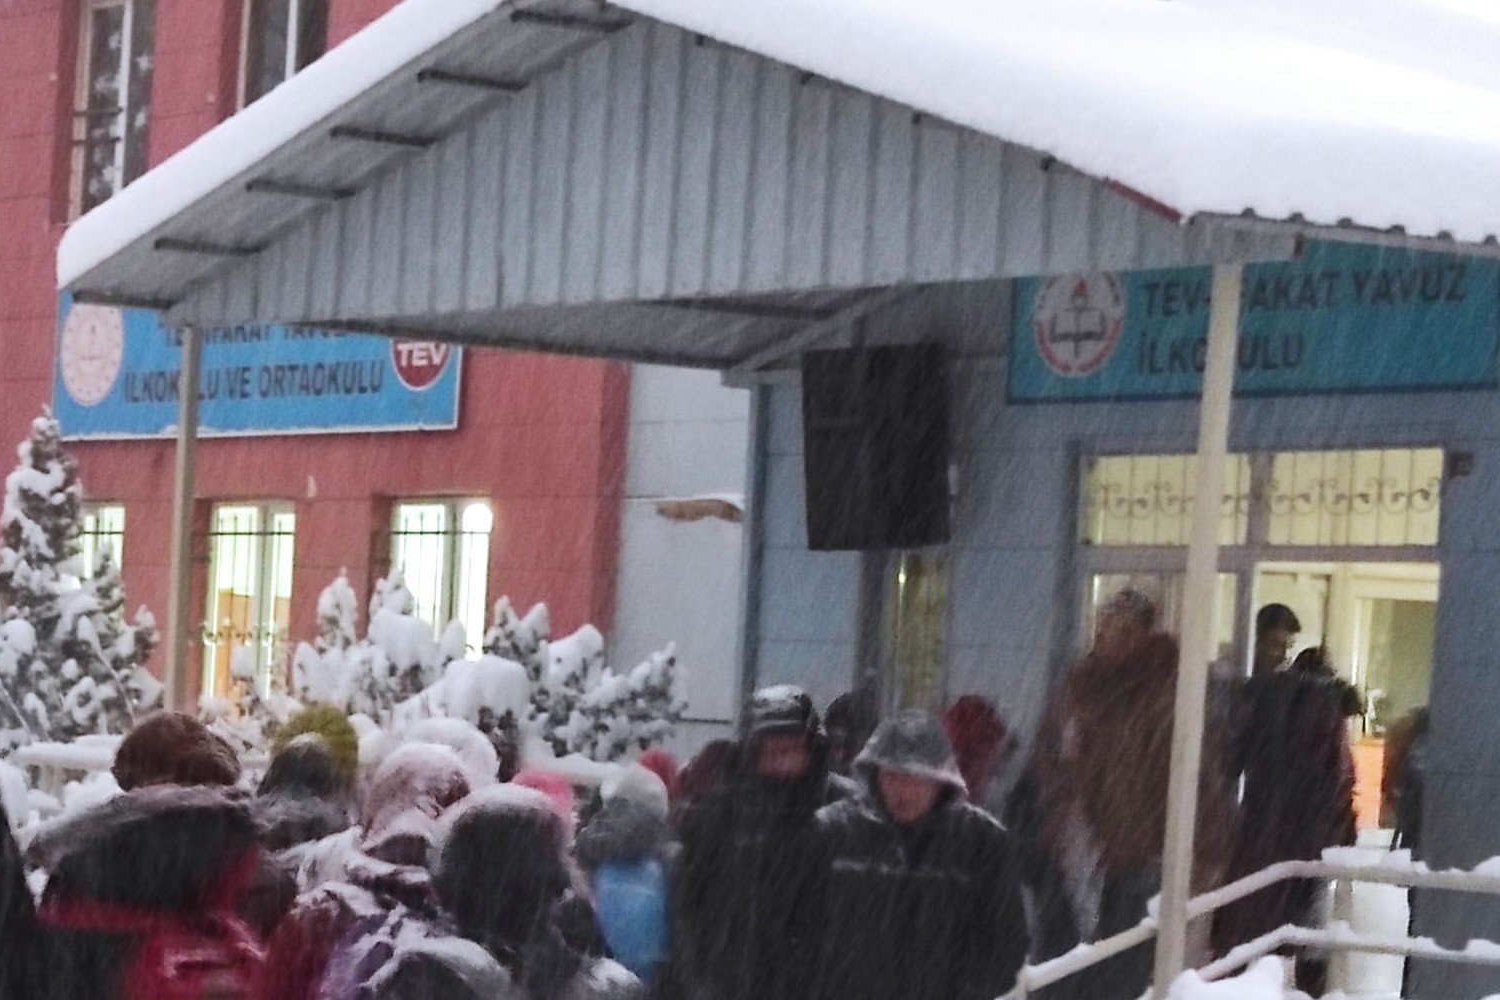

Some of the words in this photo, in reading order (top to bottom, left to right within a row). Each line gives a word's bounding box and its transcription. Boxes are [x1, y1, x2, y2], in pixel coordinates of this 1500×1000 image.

[1351, 264, 1467, 305] YAVUZ
[397, 343, 447, 367] TEV
[1139, 330, 1303, 374] İLKOULU
[226, 365, 251, 400] VE
[259, 361, 384, 398] ORTAOKULU
